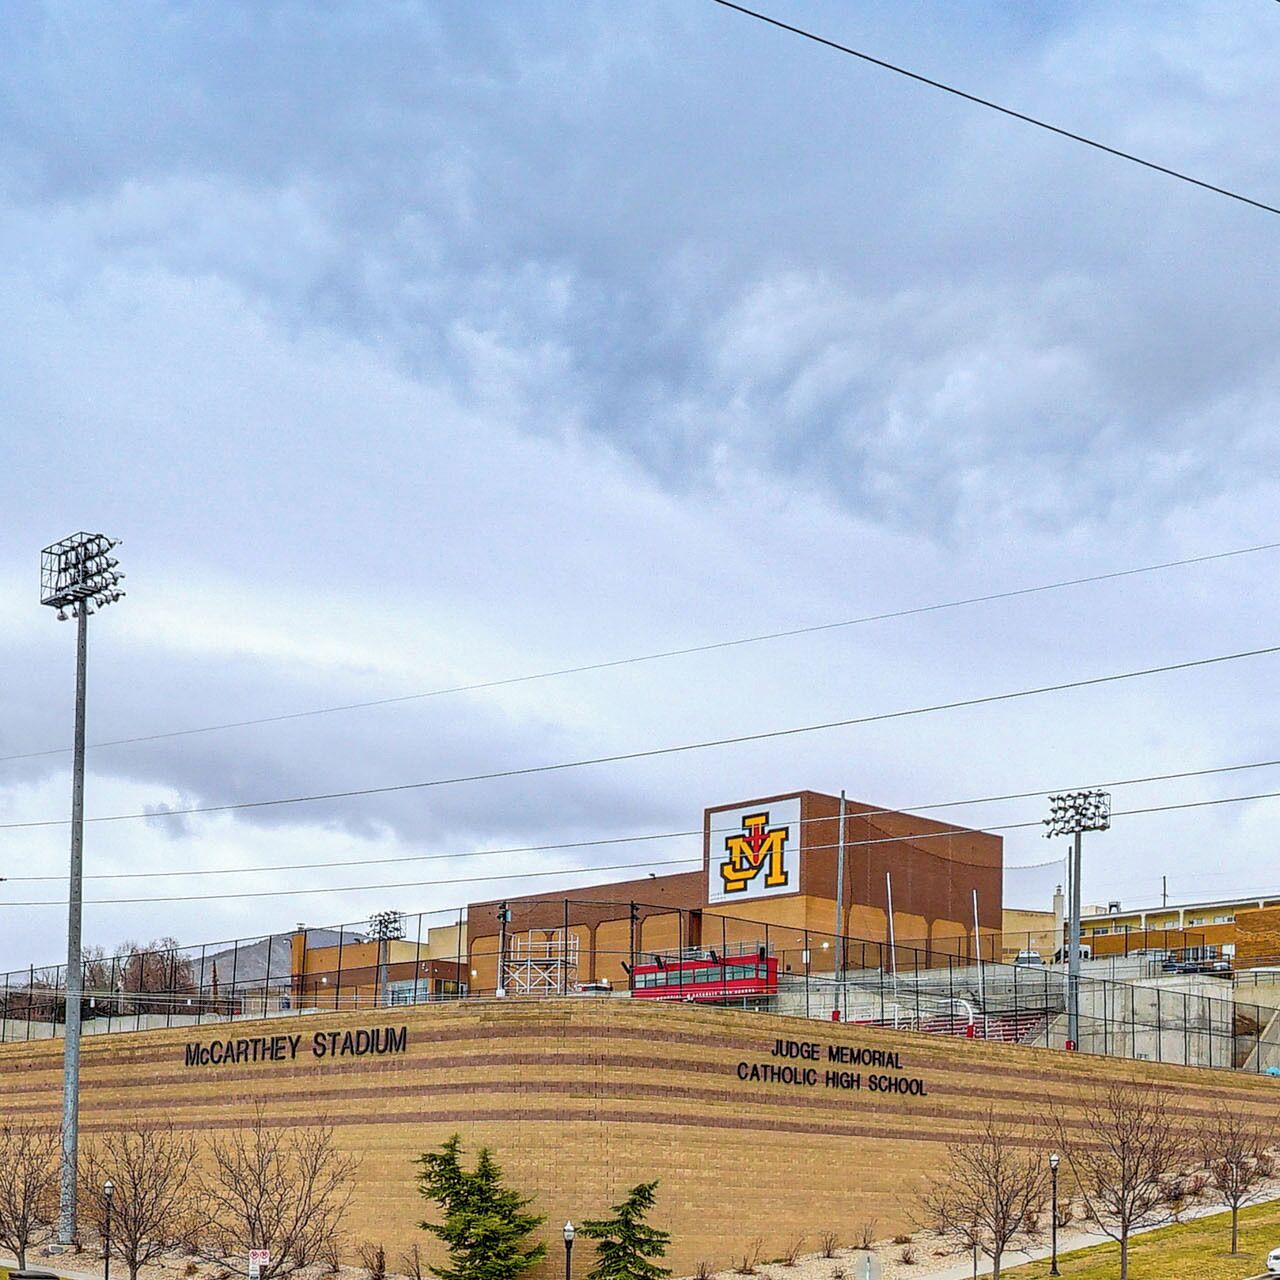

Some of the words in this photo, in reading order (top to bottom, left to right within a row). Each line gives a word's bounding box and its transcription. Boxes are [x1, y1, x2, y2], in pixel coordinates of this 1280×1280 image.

[185, 1034, 301, 1066] McCARTHEY
[312, 1026, 407, 1058] STADIUM
[771, 1039, 821, 1061] JUDGE
[828, 1045, 903, 1069] MEMORIAL
[737, 1062, 817, 1086] CATHOLIC
[825, 1070, 861, 1090] HIGH
[868, 1075, 928, 1096] SCHOOL
